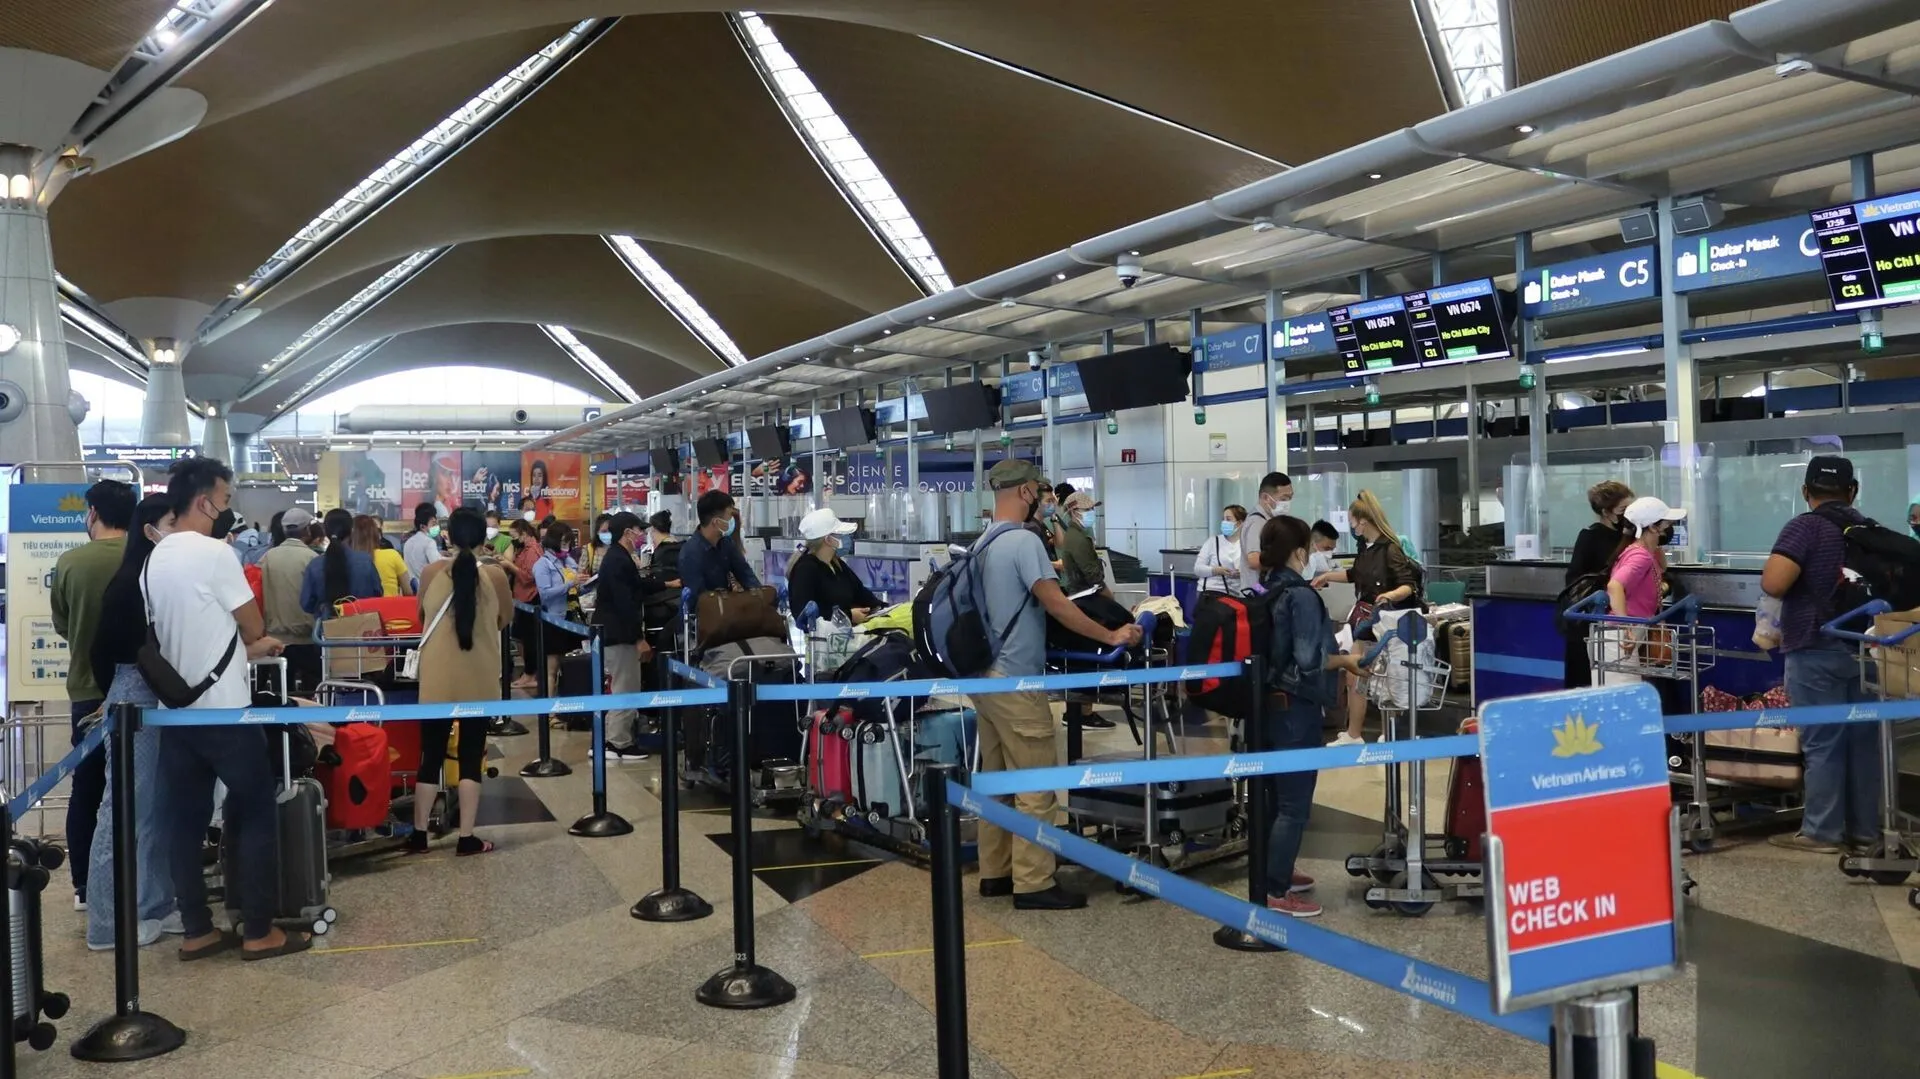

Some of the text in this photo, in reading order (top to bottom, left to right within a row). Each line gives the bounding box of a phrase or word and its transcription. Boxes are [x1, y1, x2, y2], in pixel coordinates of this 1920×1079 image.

[1889, 219, 1915, 238] VN
[1875, 255, 1914, 271] Ho Chi
[1619, 259, 1649, 288] C5
[1842, 284, 1864, 297] C31
[1446, 303, 1460, 316] VN
[1365, 319, 1378, 330] VN
[1441, 331, 1451, 340] Ho
[1243, 334, 1260, 354] C7
[1424, 348, 1438, 358] C31
[1032, 376, 1042, 392] C9
[936, 481, 966, 493] YOU
[31, 514, 73, 524] Vietnam
[1365, 754, 1394, 762] AIRPORTS
[1233, 764, 1264, 773] AIRPORTS
[1090, 776, 1123, 785] AIRPORTS
[1531, 764, 1627, 790] Vietnam Airlines
[1508, 876, 1560, 906] WEB
[1511, 893, 1616, 935] CHECK IN
[1254, 924, 1288, 944] AIRPORTS
[1413, 981, 1457, 1005] AIRPORTS
